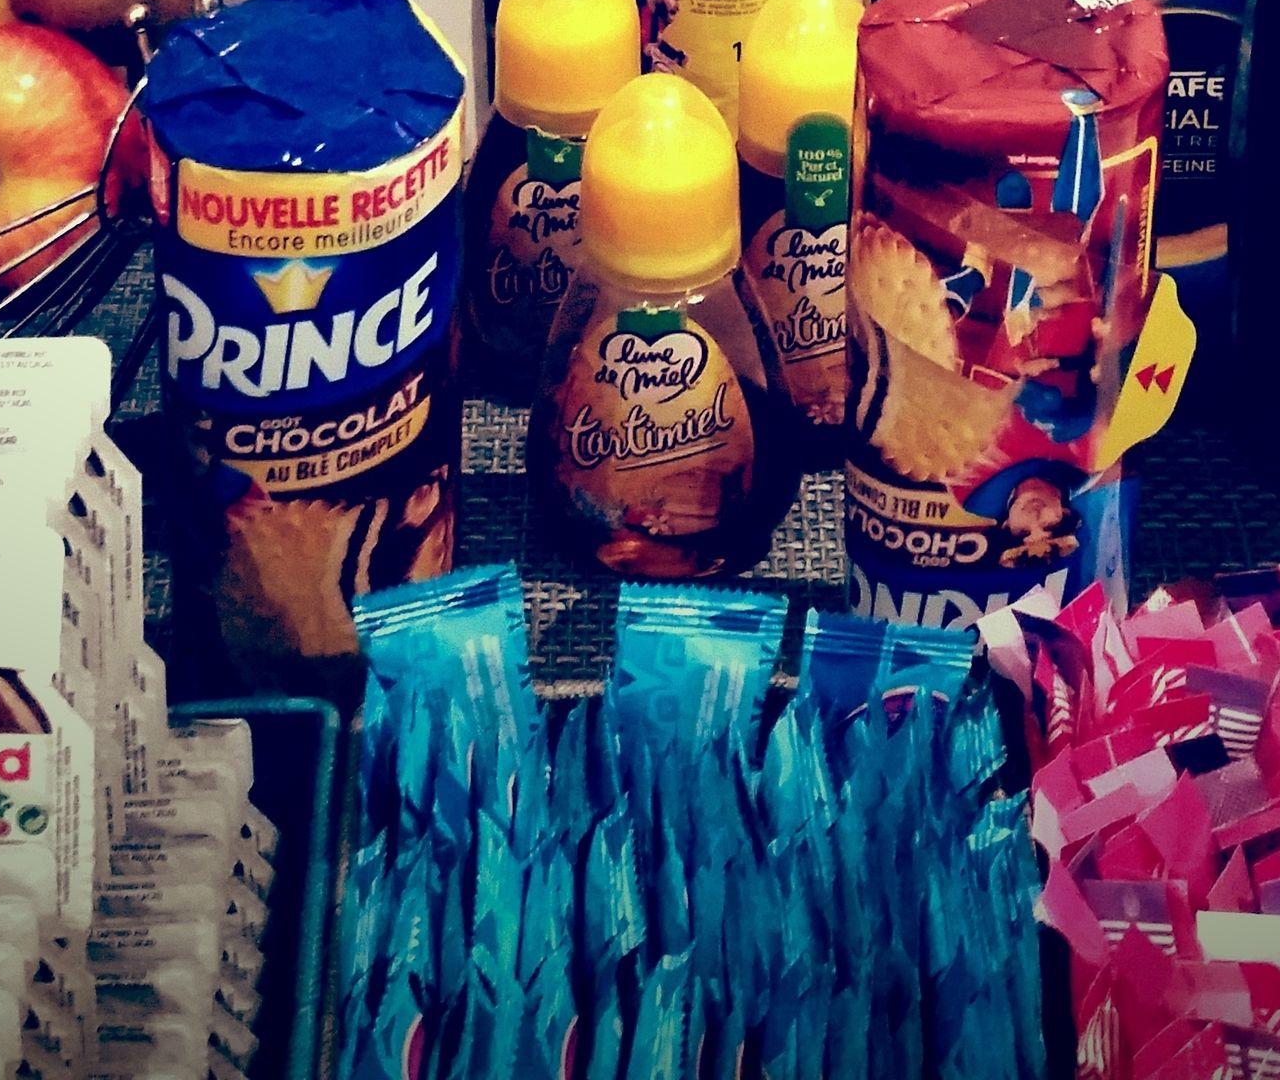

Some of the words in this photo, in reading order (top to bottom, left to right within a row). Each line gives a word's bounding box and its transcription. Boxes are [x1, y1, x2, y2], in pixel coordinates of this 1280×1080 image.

[1165, 108, 1219, 130] IAL
[796, 168, 844, 183] Naturel
[797, 149, 825, 161] 100
[801, 160, 824, 172] Pur
[180, 185, 340, 230] NOUVELLE
[351, 136, 450, 224] RECETTE
[228, 229, 305, 251] Encore
[162, 251, 438, 398] PRINCE
[620, 357, 696, 404] miel
[225, 371, 424, 454] CHOCOLAT
[565, 382, 735, 470] tartimiel
[265, 466, 290, 483] AU
[335, 419, 412, 472] COMPLET
